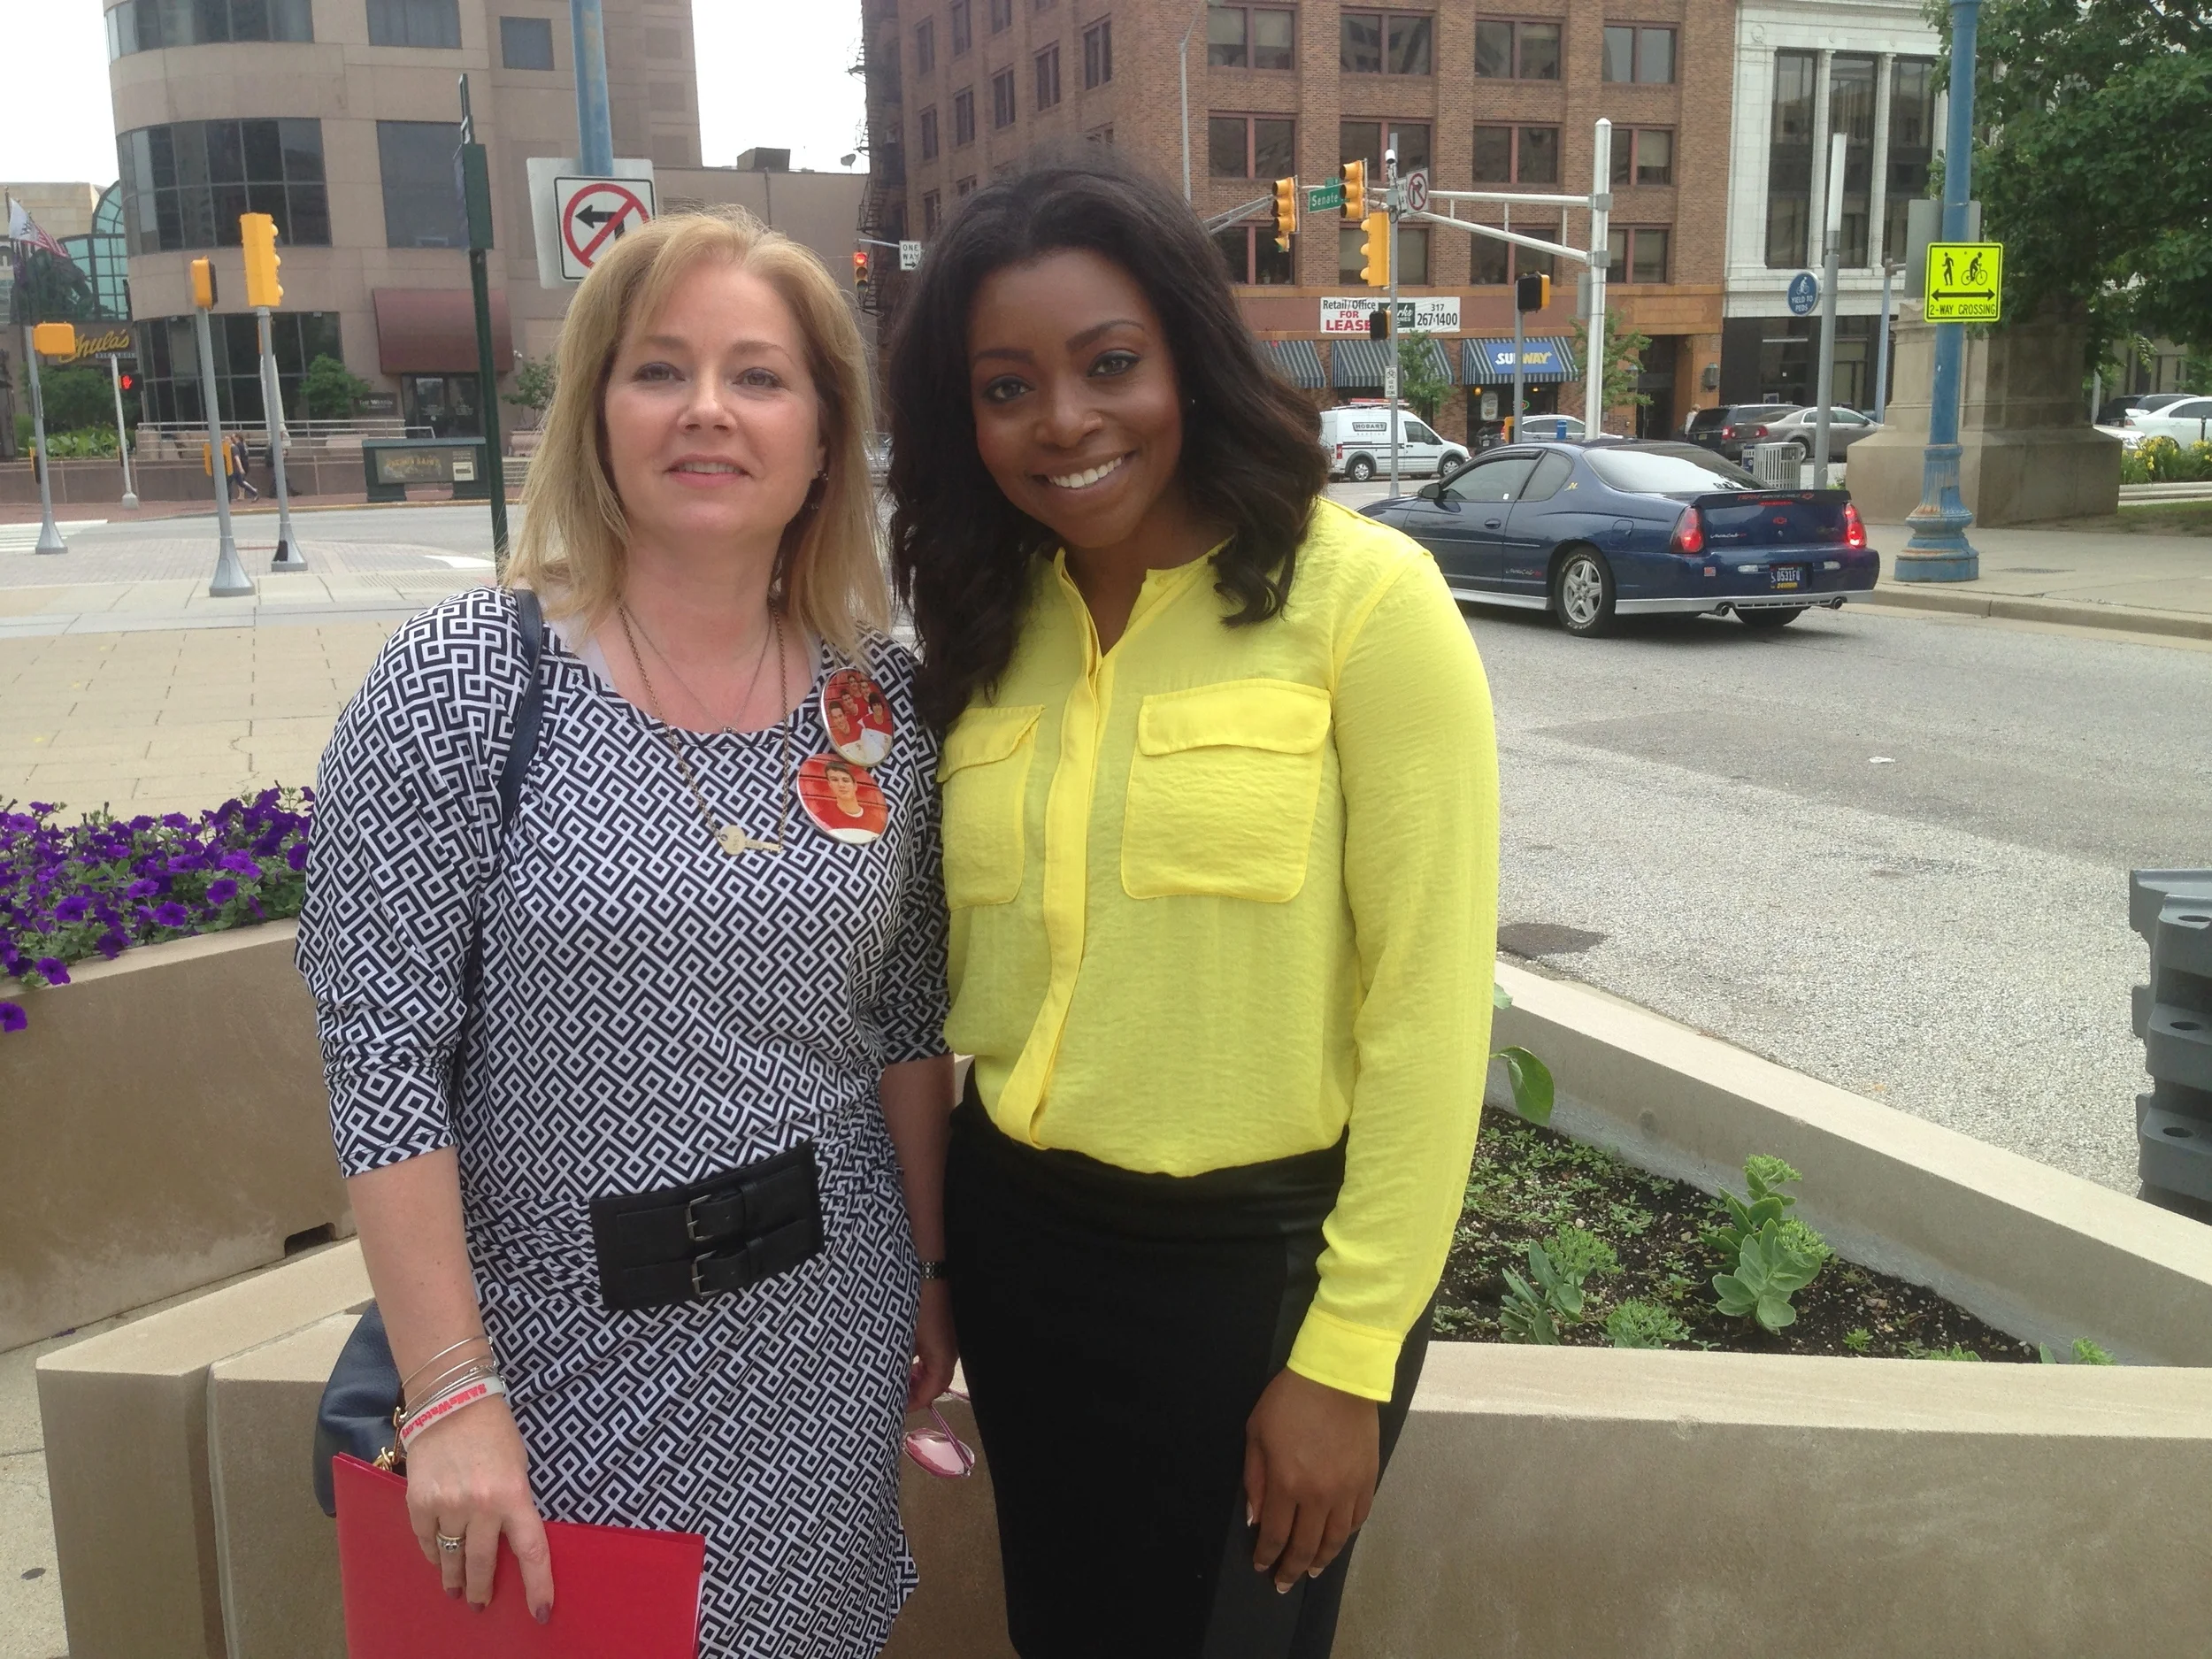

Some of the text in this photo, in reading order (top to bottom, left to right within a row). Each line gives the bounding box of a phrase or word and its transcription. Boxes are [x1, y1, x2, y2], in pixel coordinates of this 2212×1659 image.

[1311, 192, 1339, 207] Senate
[1930, 303, 1996, 316] 2-WAY CROSSING
[1495, 351, 1553, 365] SUWAY
